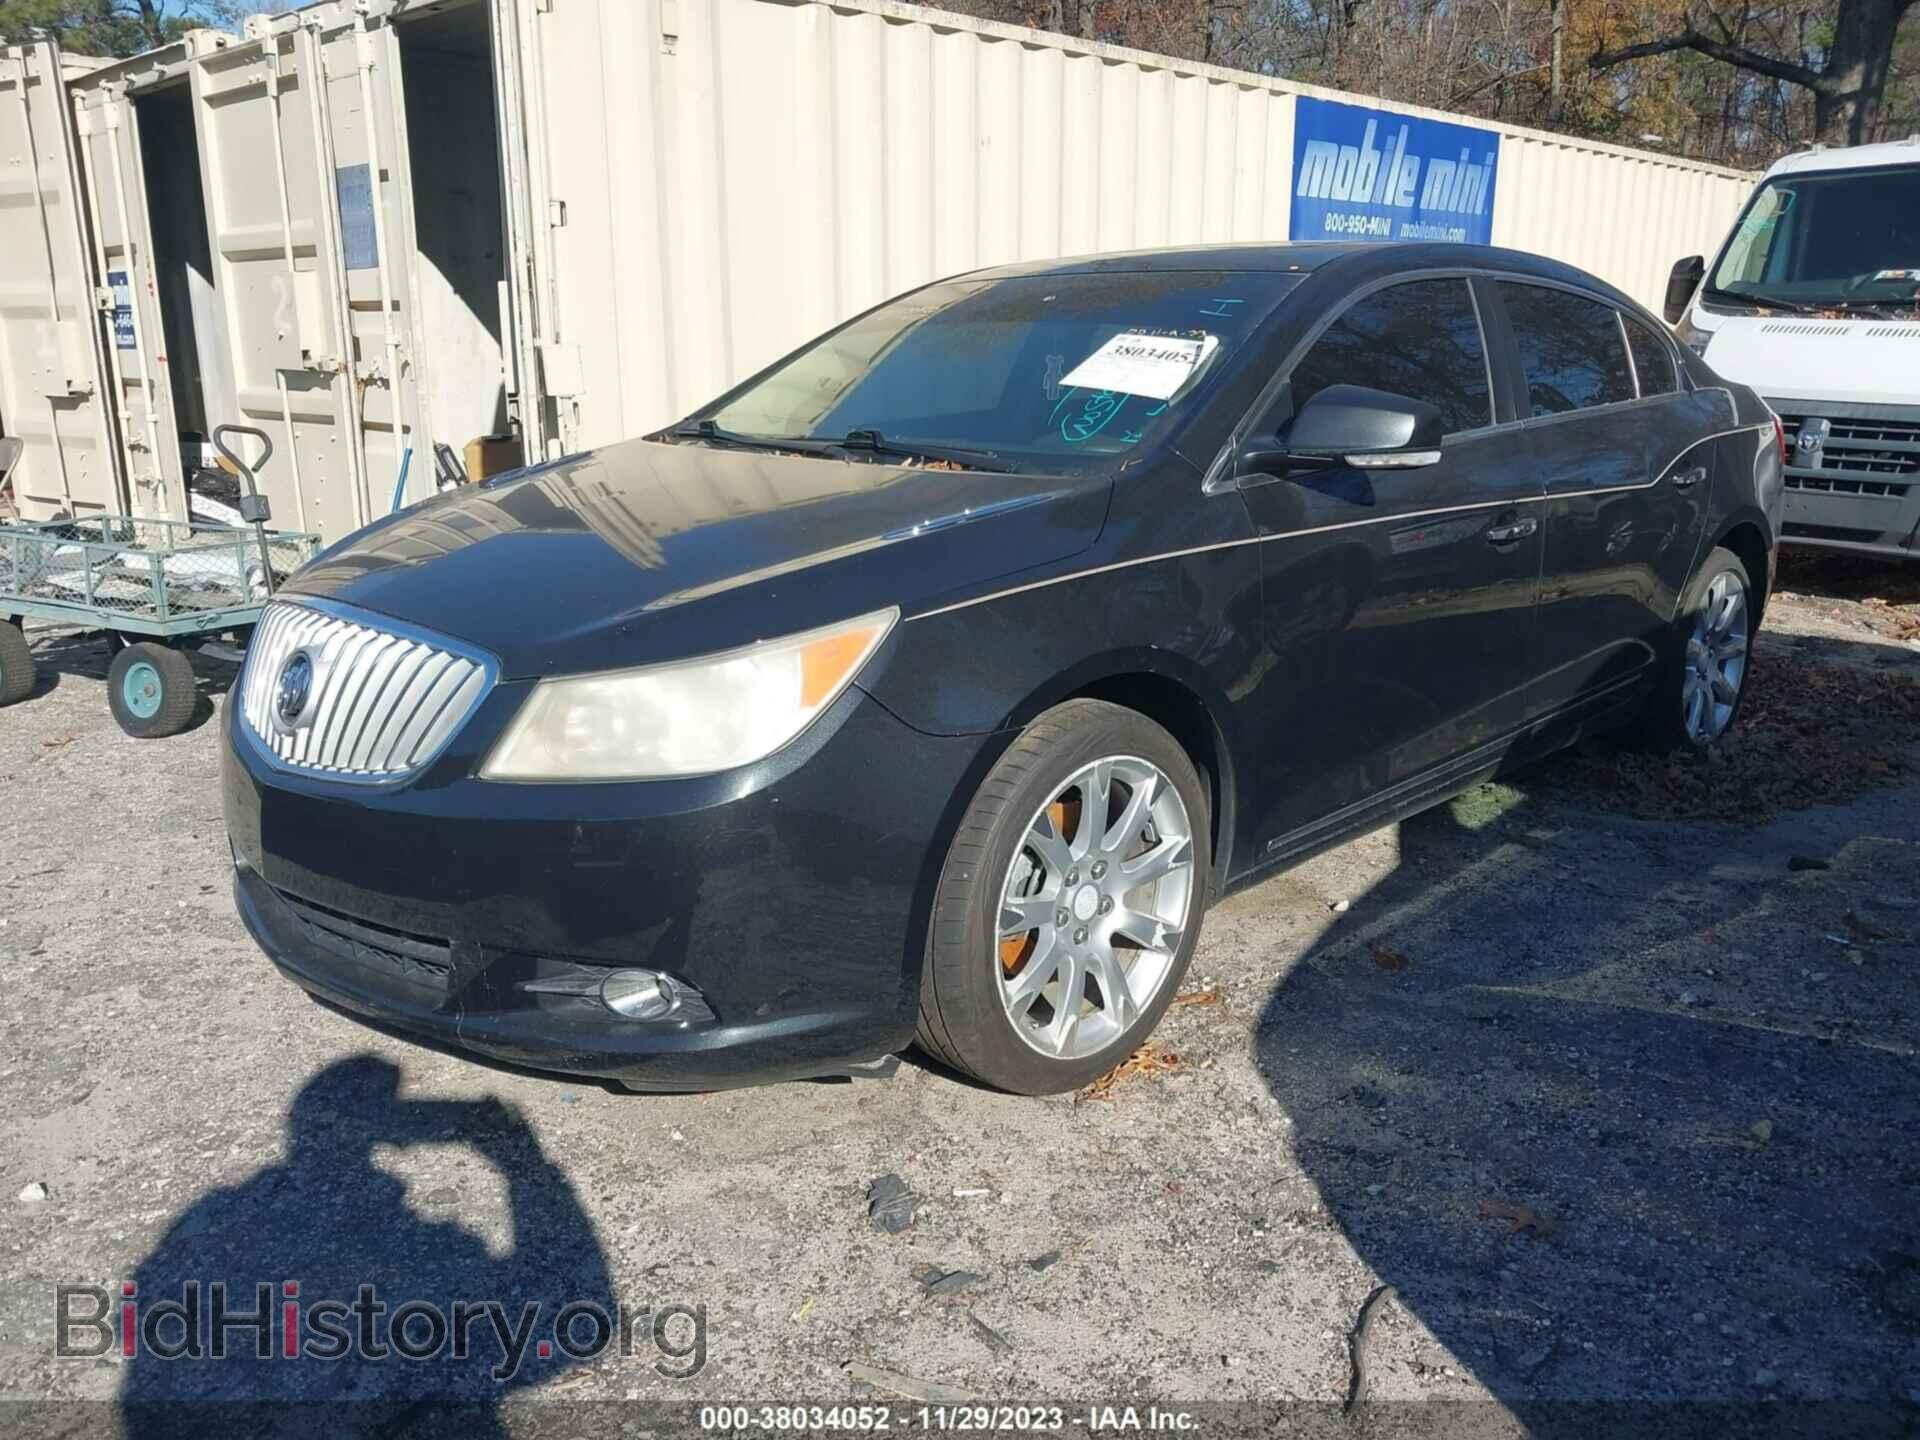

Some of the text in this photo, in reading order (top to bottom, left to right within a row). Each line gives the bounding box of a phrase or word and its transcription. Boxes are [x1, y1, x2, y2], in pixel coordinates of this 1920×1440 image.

[1297, 119, 1495, 215] mobile mini
[1325, 212, 1392, 236] 800-950-MINI
